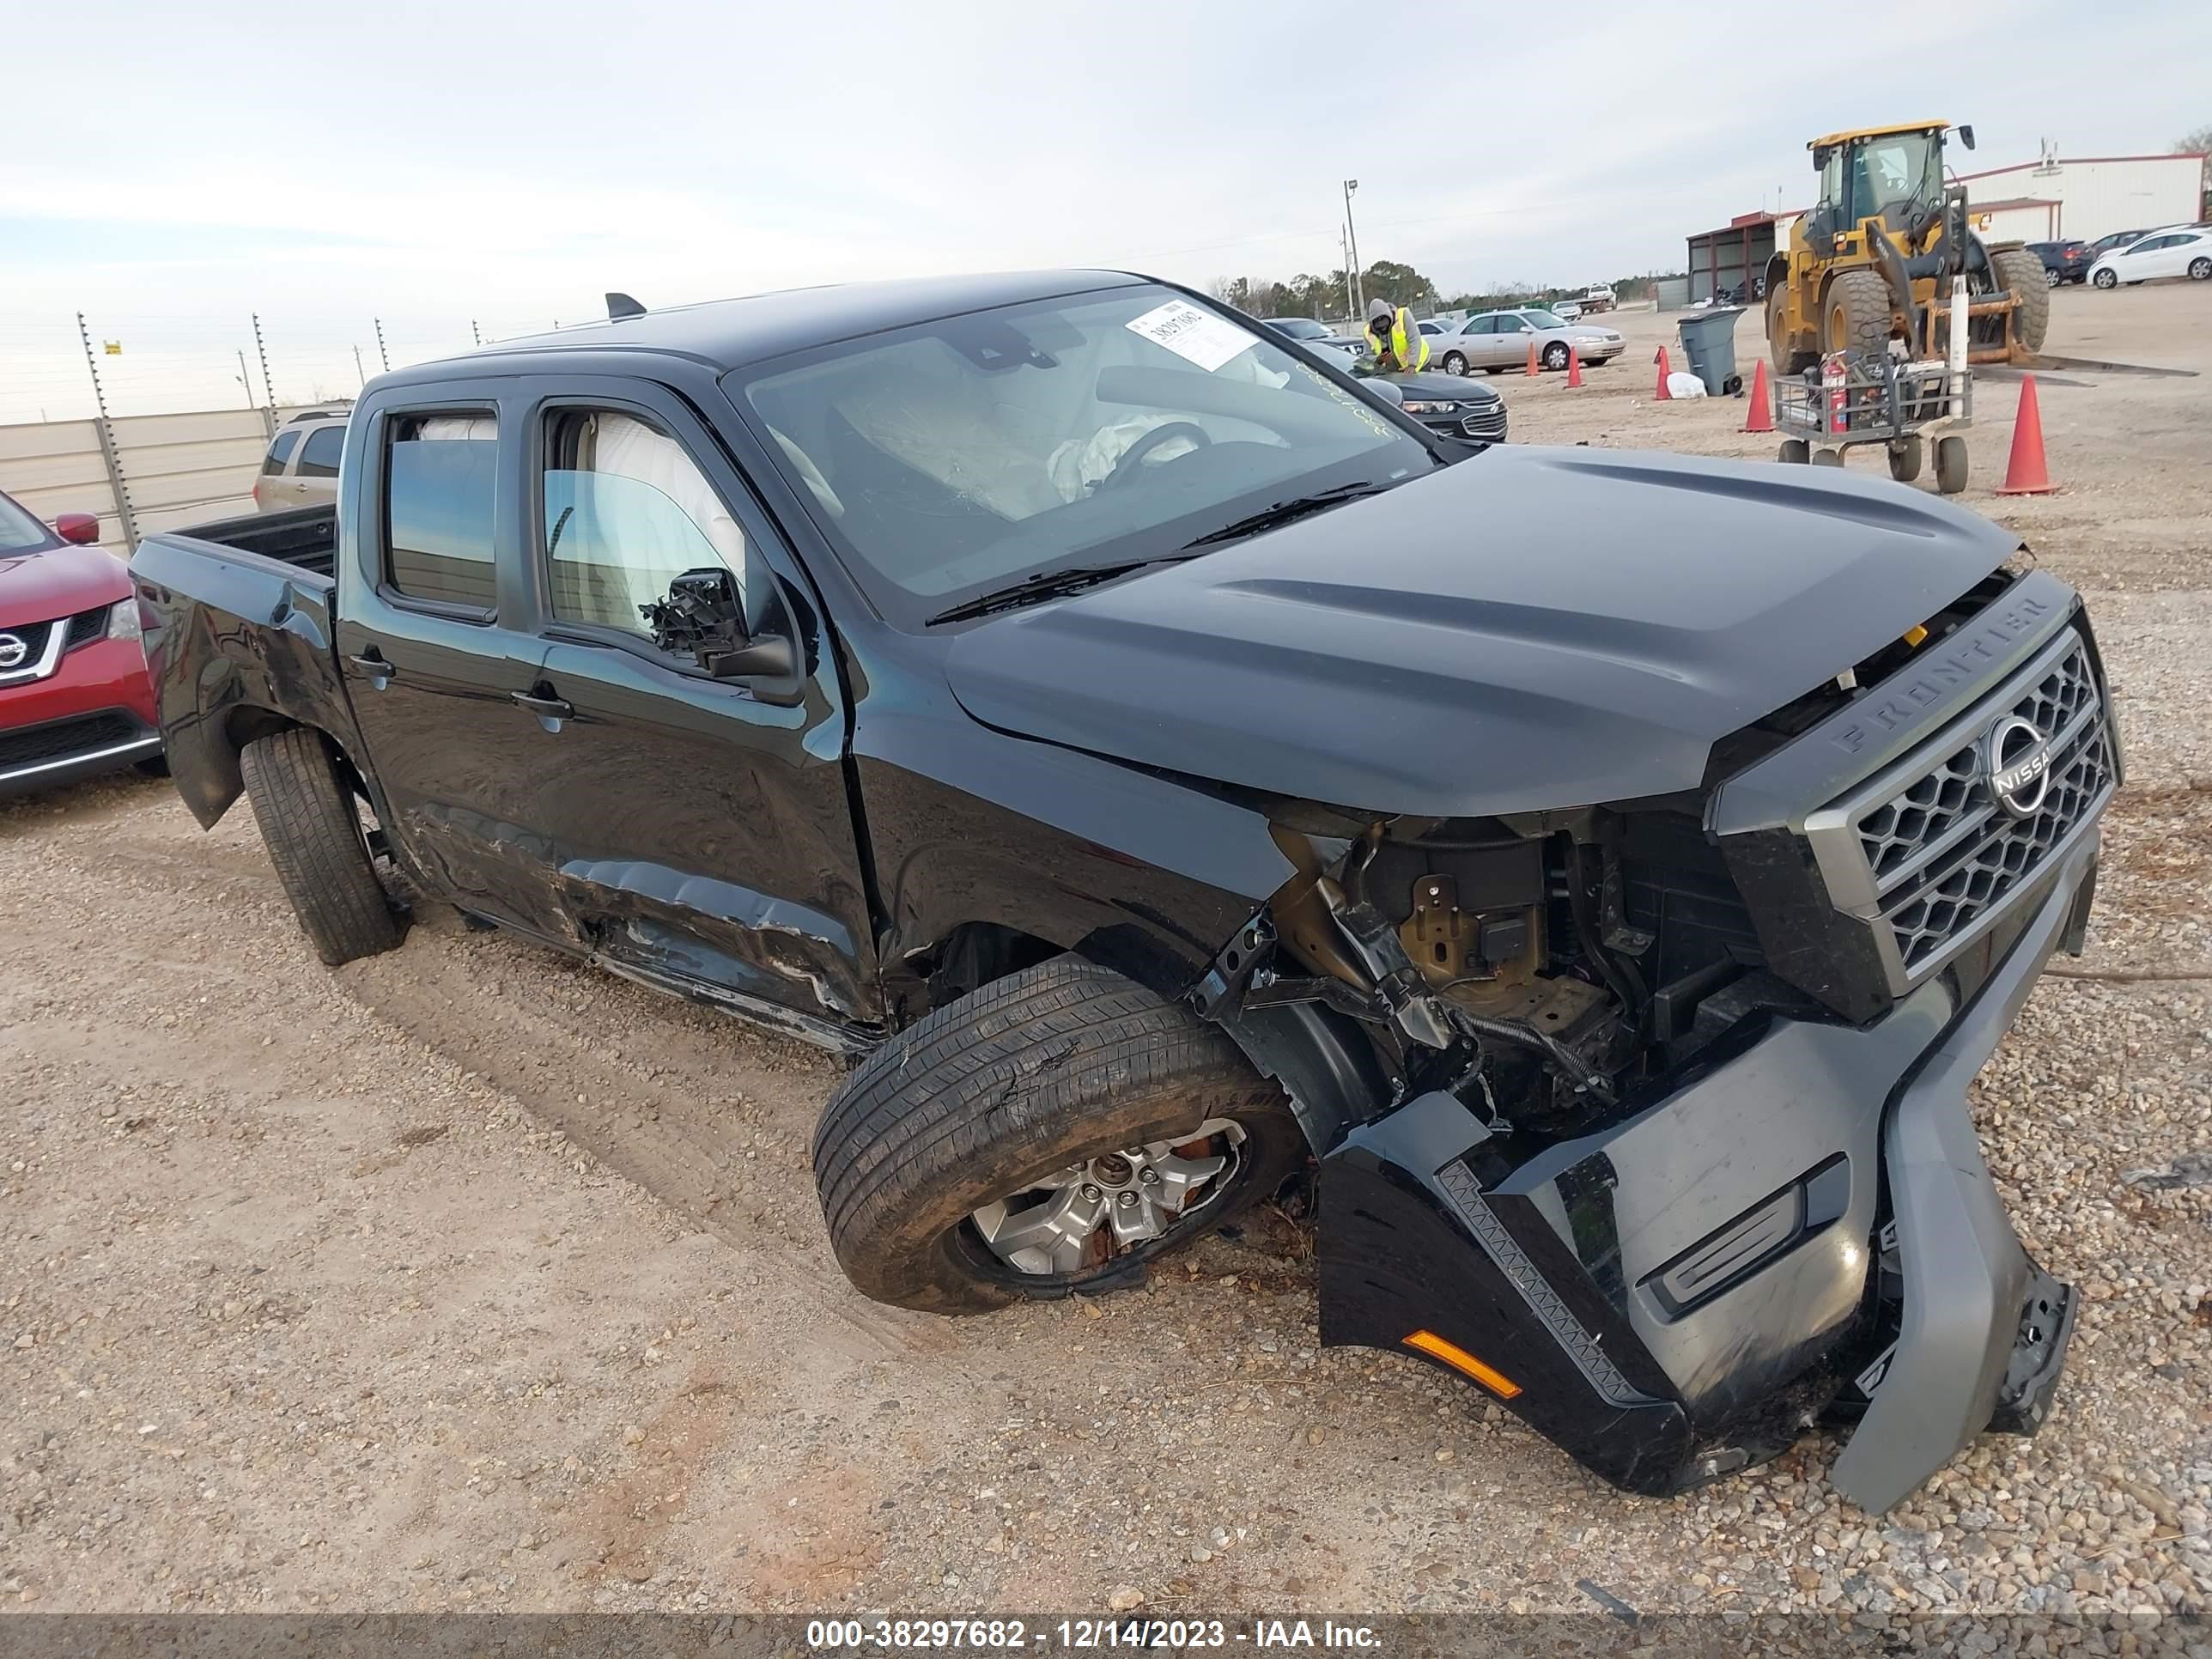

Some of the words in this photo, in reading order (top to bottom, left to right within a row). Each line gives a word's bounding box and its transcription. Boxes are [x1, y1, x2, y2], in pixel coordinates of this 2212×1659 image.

[1150, 311, 1202, 340] 38297682
[1831, 597, 2049, 755] FRONTIER
[1996, 746, 2051, 793] NISSA
